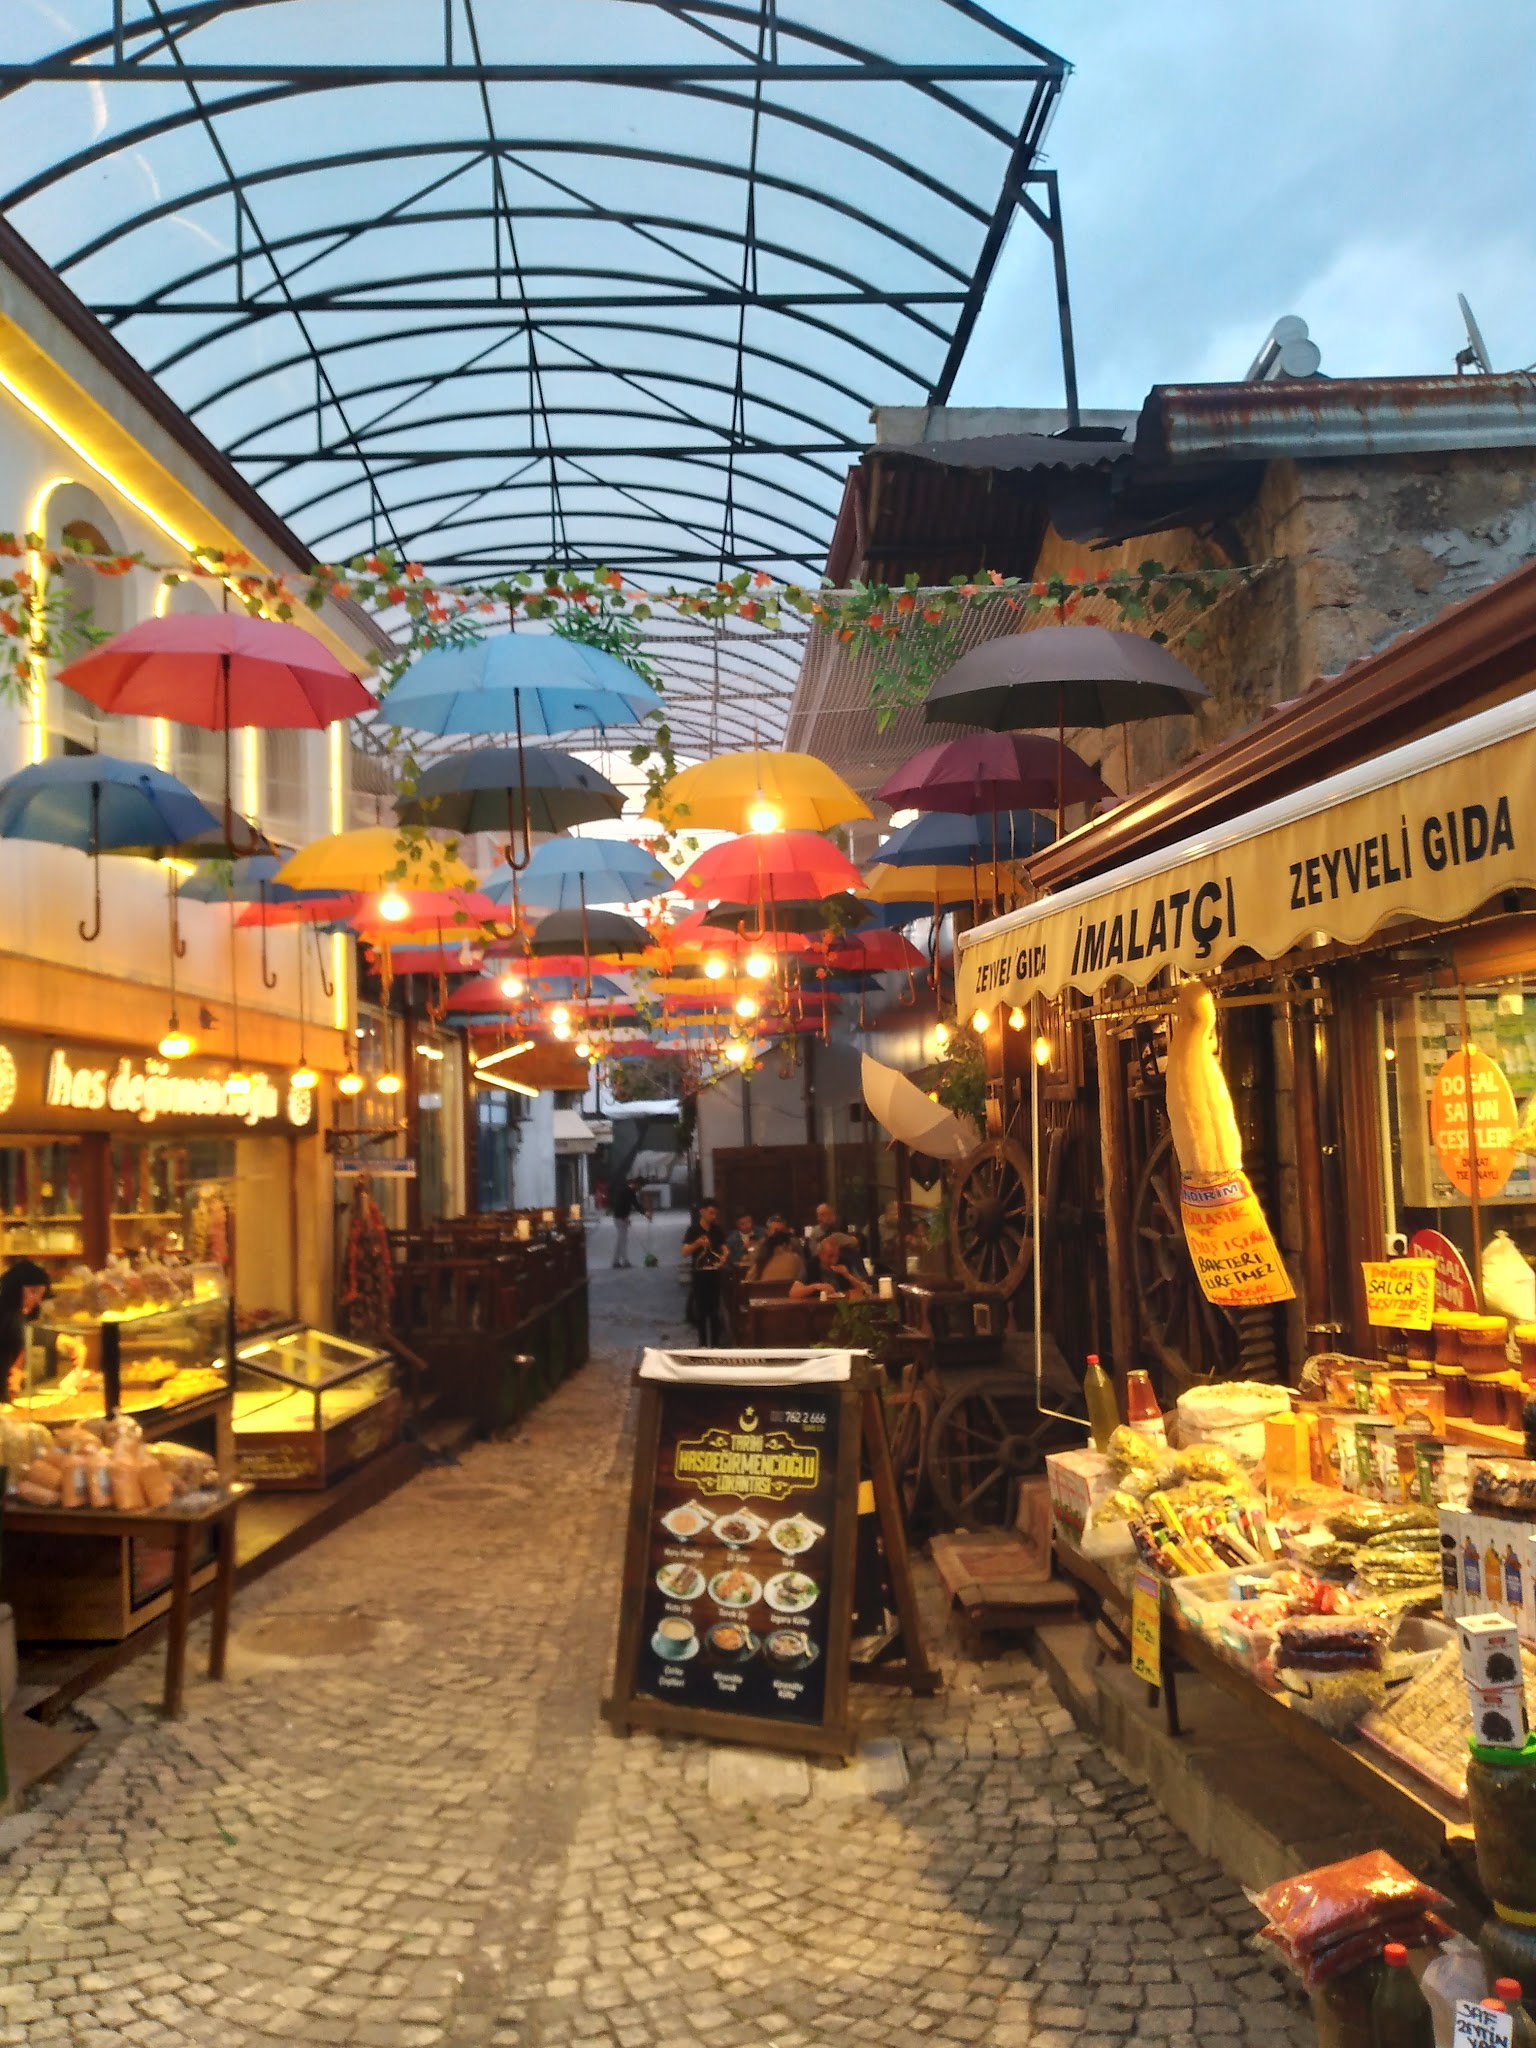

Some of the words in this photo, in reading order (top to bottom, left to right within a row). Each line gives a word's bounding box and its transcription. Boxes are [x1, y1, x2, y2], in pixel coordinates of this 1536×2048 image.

[1290, 814, 1413, 911] ZEYVELİ
[1422, 796, 1517, 872] GIDA
[1016, 944, 1047, 980] GIDA
